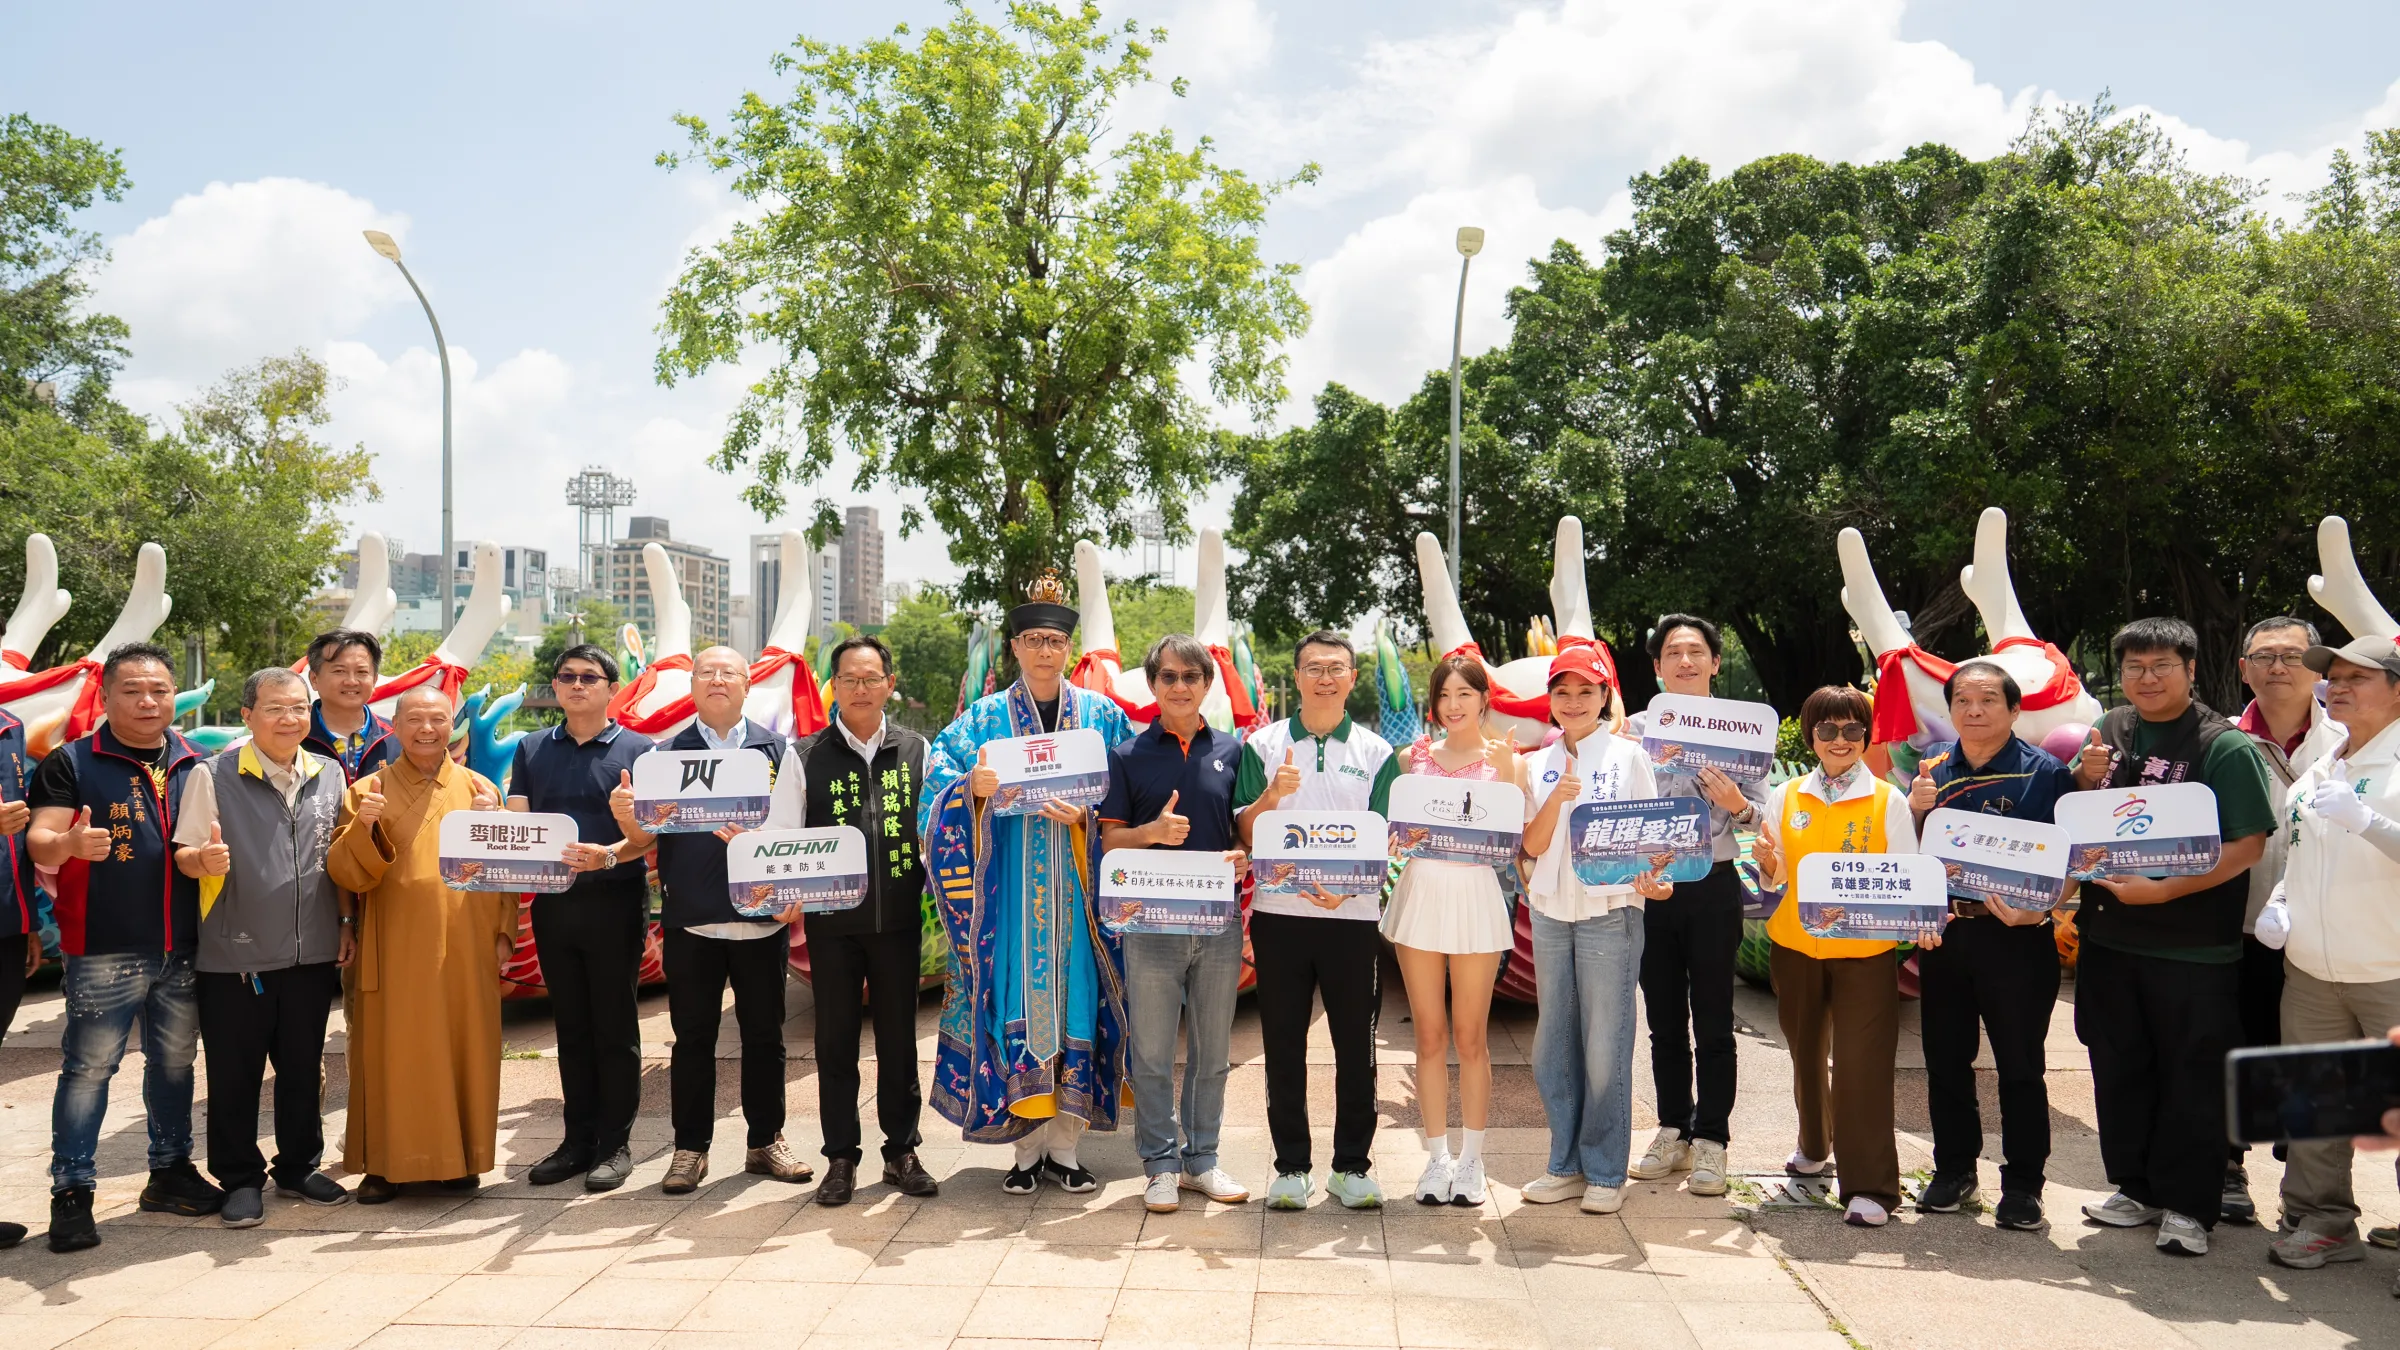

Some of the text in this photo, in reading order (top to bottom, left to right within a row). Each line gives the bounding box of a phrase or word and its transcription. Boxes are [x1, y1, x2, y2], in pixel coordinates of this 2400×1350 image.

[1679, 714, 1762, 735] MR. BROWN
[1684, 751, 1706, 760] 2026
[848, 770, 862, 808] 執行長
[900, 761, 912, 808] 立法委員
[1026, 786, 1048, 794] 2026
[129, 776, 146, 823] 里長主席
[880, 769, 902, 837] 賴瑞隆
[1432, 799, 1454, 807] 佛光山
[109, 802, 135, 862] 顏炳豪
[470, 824, 548, 844] 麥根沙士
[1309, 824, 1357, 844] KSD
[1432, 834, 1454, 842] 2026
[1580, 814, 1702, 849] 龍躍愛河
[486, 843, 508, 851] Root
[754, 838, 840, 858] NOHMI
[901, 842, 914, 870] 服務
[2112, 850, 2138, 858] 2026
[766, 861, 826, 874] 能美防災
[889, 850, 902, 878] 團隊
[1132, 877, 1225, 890] 日月光環保永續基金會
[1831, 877, 1912, 892] 高雄愛河水域
[1964, 871, 1988, 881] 2026
